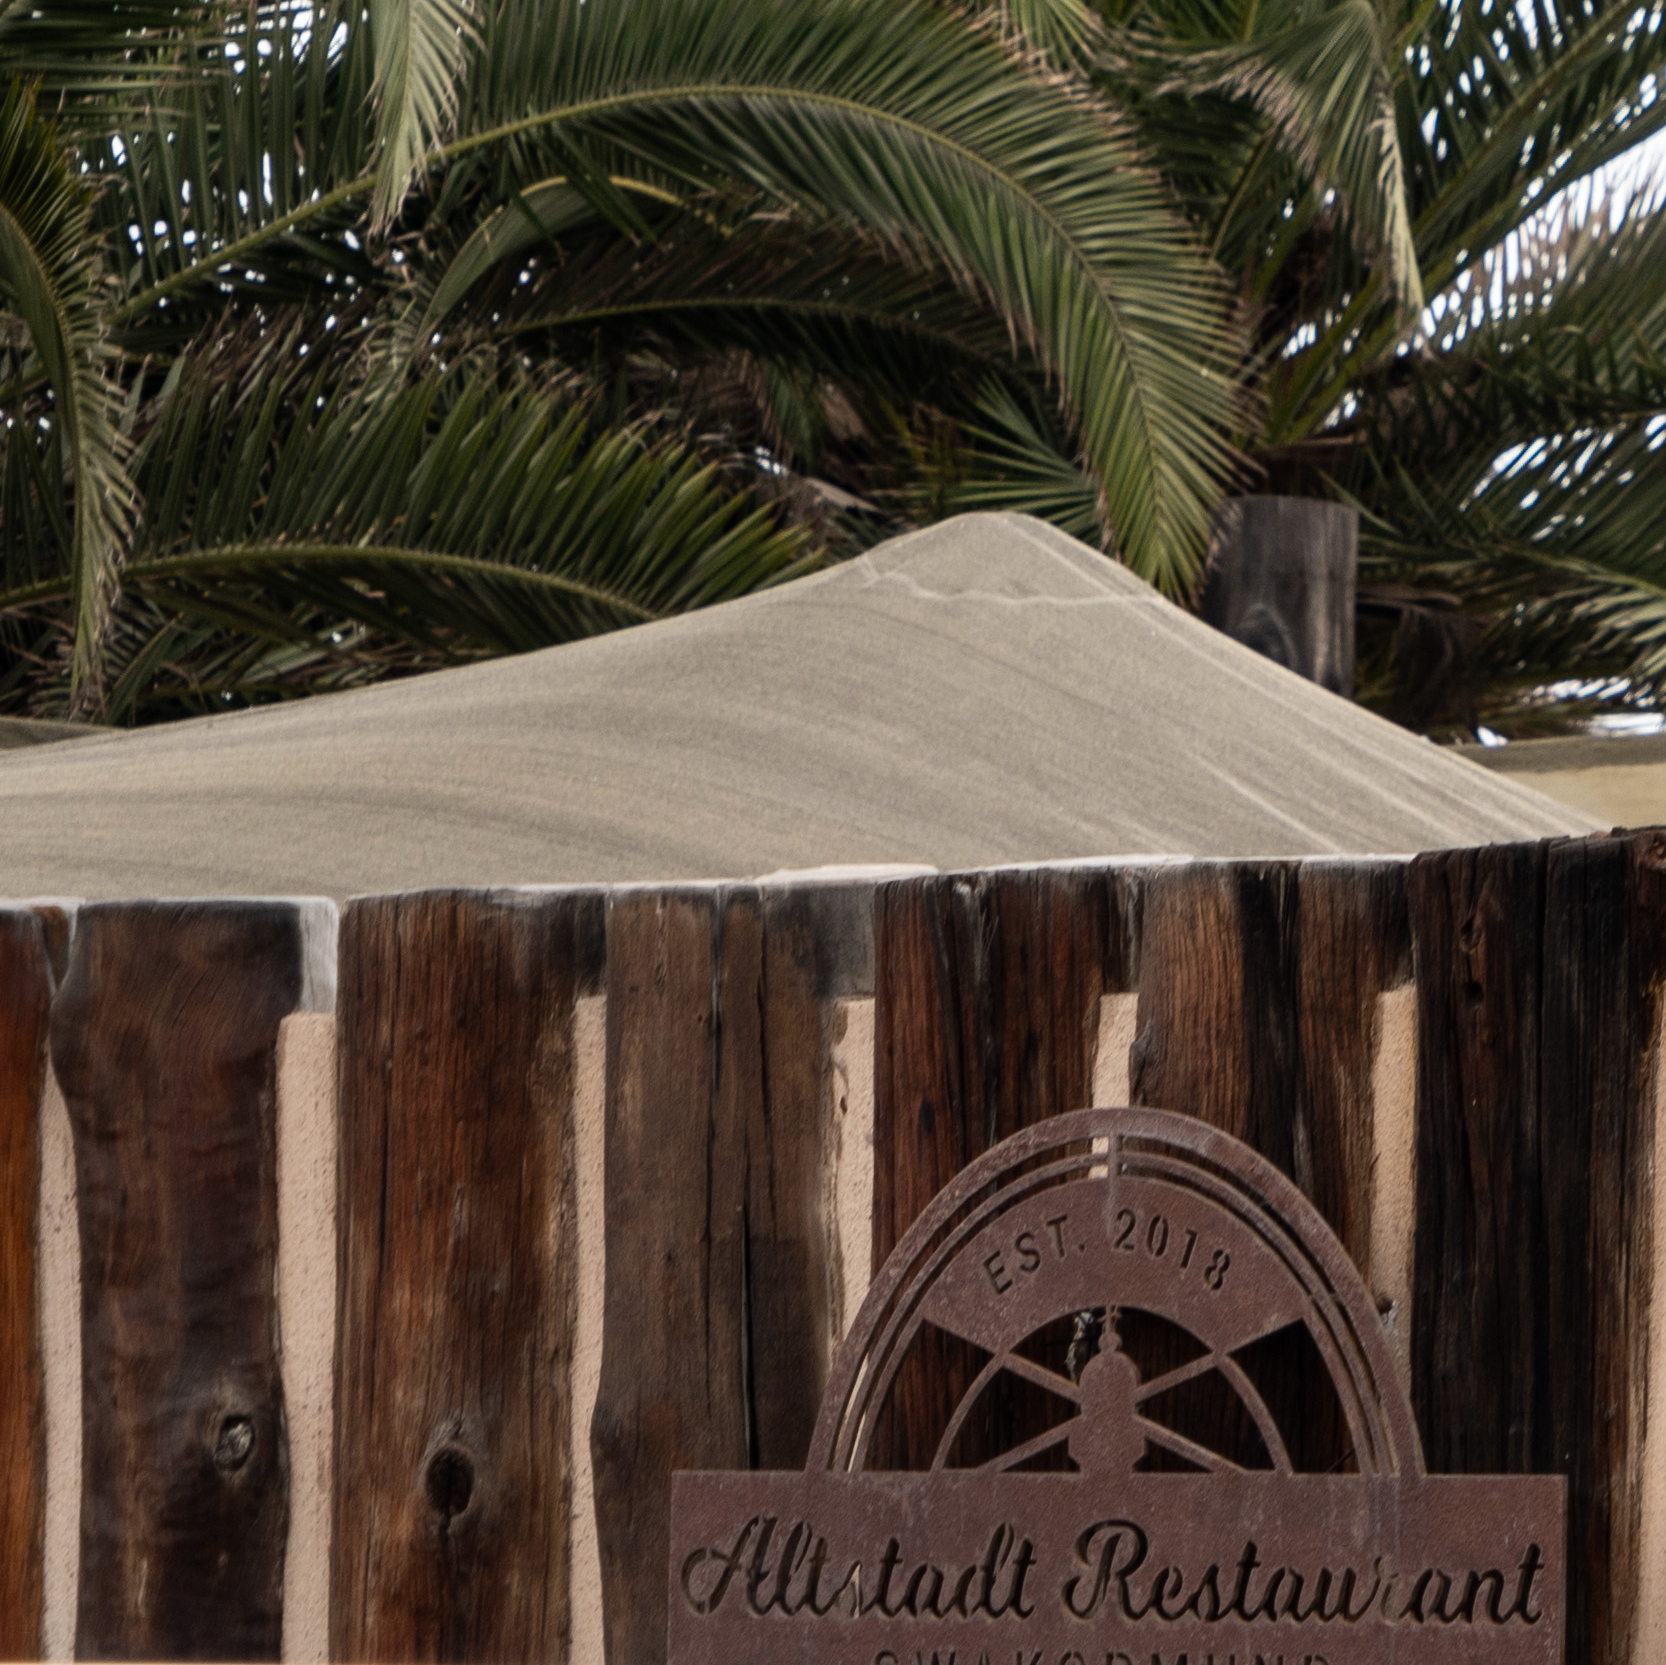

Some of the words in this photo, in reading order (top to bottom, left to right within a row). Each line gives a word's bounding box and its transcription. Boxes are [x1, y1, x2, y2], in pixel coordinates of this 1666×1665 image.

[984, 1214, 1085, 1294] EST.
[1114, 1208, 1230, 1291] 2018
[680, 1516, 1036, 1619] Altstadt
[1061, 1519, 1544, 1624] Restaurant
